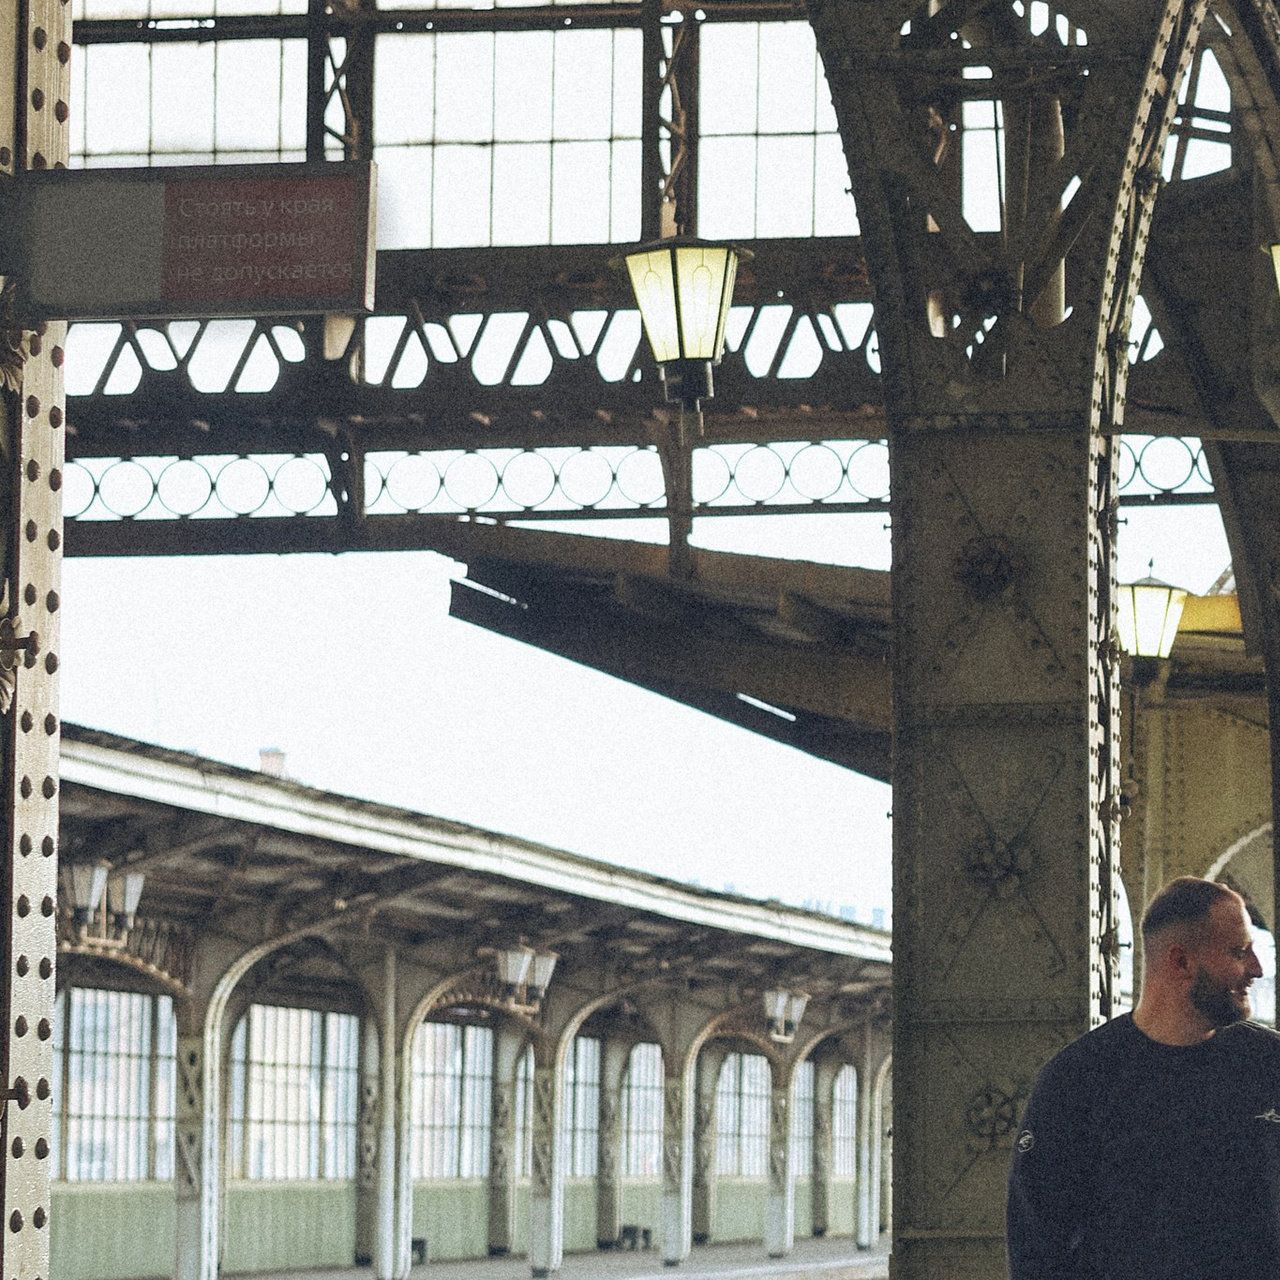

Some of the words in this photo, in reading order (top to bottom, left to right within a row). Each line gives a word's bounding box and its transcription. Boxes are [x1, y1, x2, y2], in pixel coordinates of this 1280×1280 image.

[178, 198, 257, 218] Стоять
[262, 199, 276, 220] у
[280, 198, 335, 219] края
[177, 231, 316, 255] платформы
[177, 266, 204, 282] не
[212, 262, 353, 286] допускается
